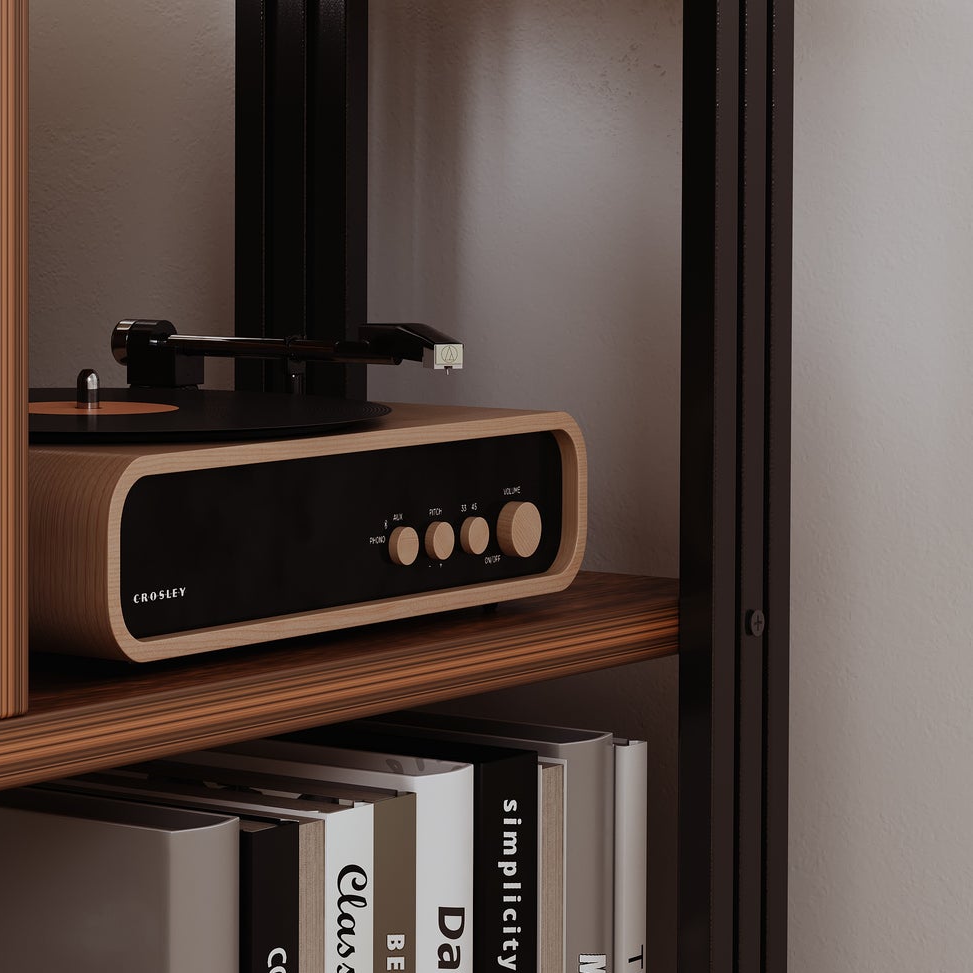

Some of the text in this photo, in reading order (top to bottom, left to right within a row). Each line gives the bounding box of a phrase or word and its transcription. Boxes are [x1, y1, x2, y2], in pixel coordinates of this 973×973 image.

[503, 486, 521, 495] VOLUME
[429, 508, 442, 516] PITCH
[393, 513, 403, 521] AUX
[369, 536, 385, 544] PHONO
[133, 587, 186, 604] CROSLEY
[497, 799, 522, 971] simplicity
[386, 934, 406, 971] BE
